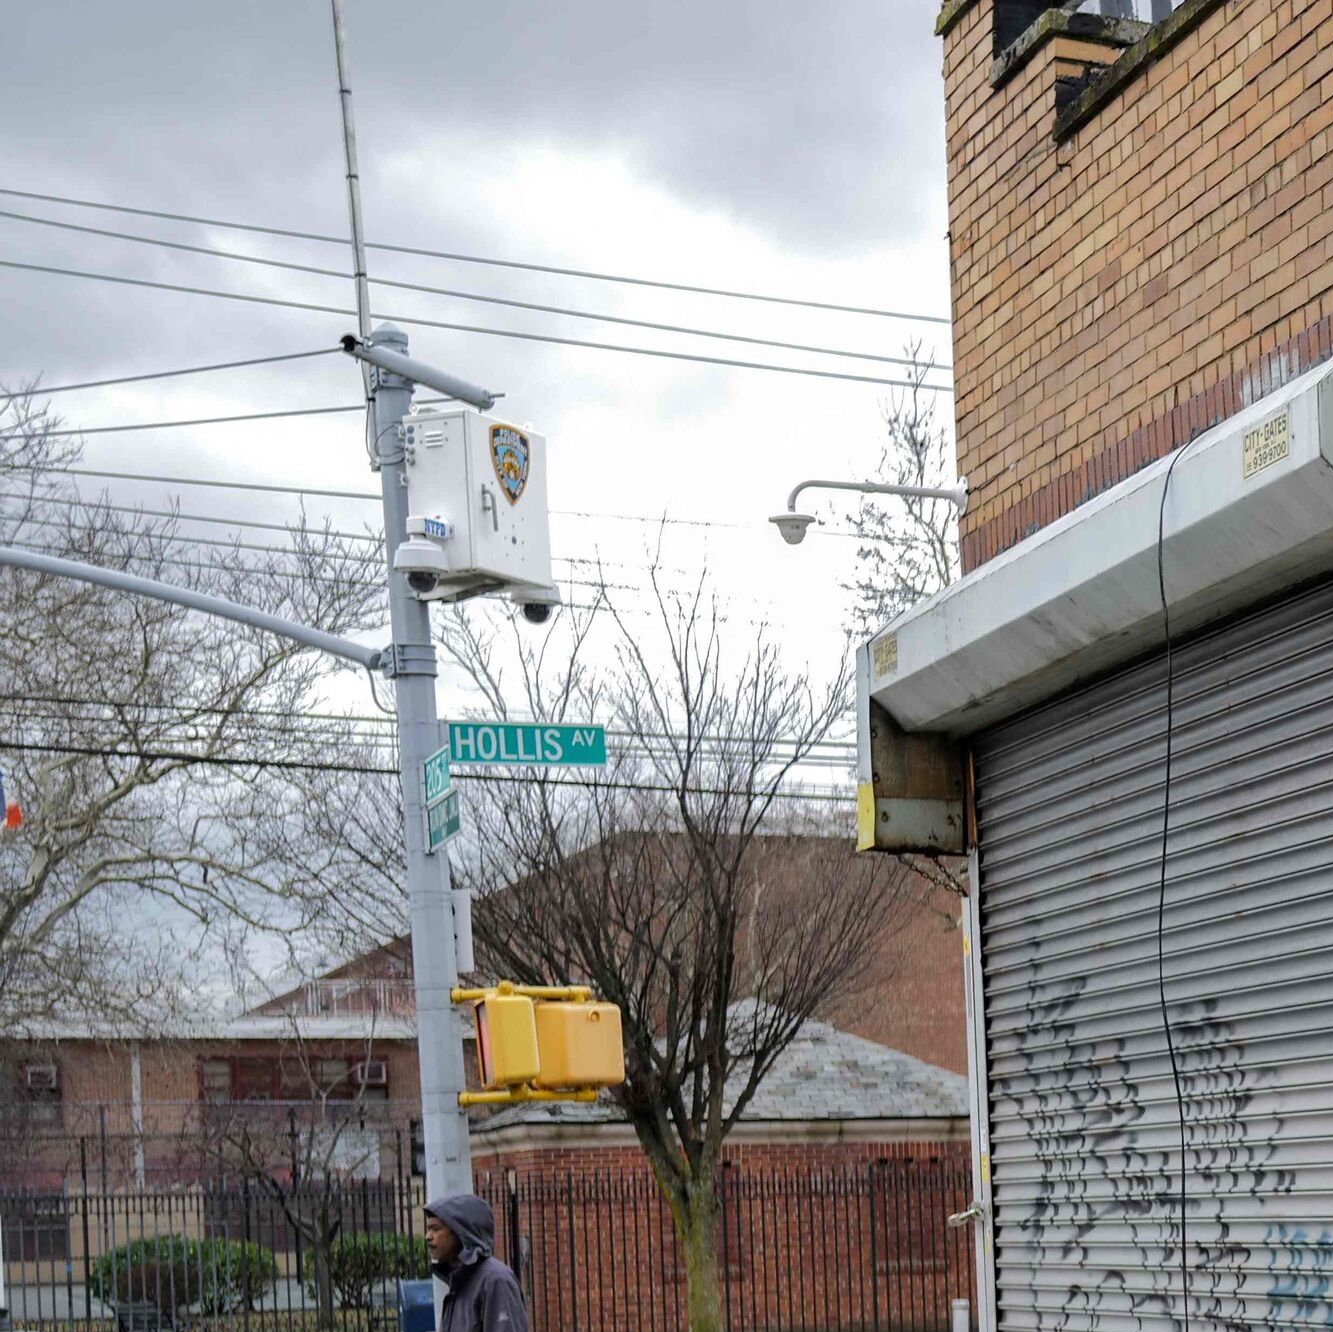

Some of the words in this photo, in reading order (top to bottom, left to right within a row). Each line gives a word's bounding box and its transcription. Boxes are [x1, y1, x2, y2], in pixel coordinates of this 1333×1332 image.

[424, 518, 446, 537] NYPD
[454, 726, 563, 761] HOLLIS
[571, 729, 596, 748] AV
